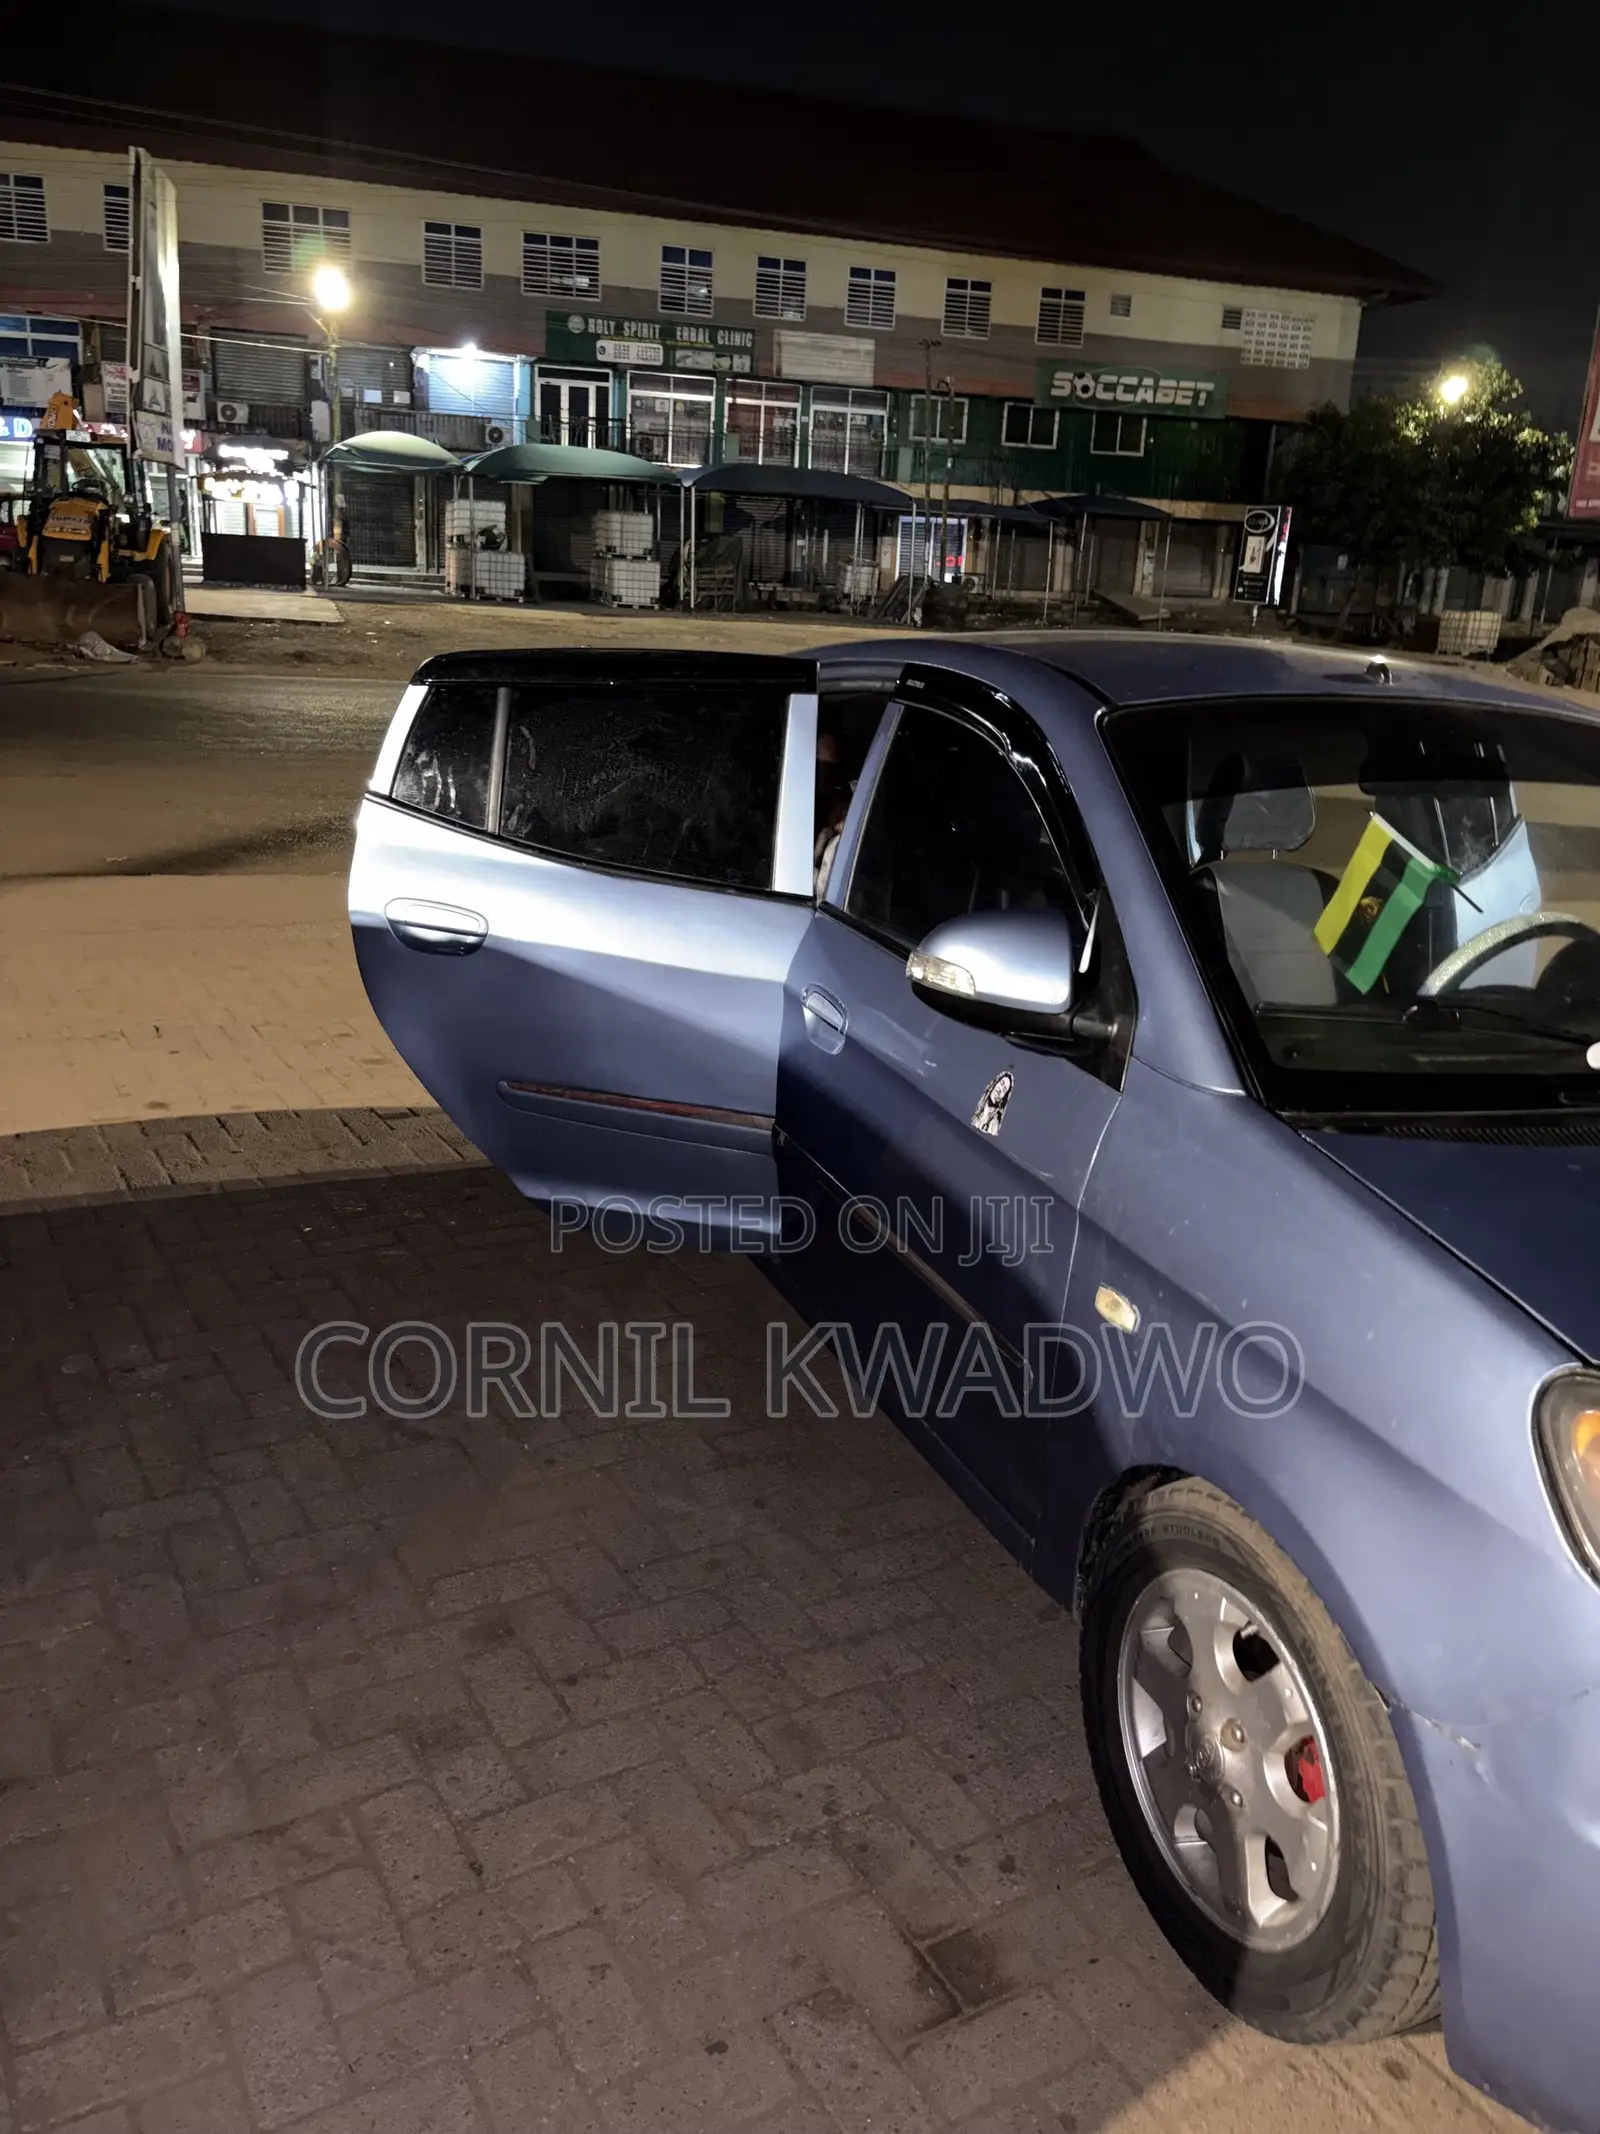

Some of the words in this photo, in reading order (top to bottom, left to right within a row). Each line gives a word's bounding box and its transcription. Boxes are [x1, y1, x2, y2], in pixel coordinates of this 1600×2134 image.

[588, 319, 616, 336] HOLY
[717, 329, 753, 348] CLINIC
[1050, 369, 1216, 408] SOCCABET
